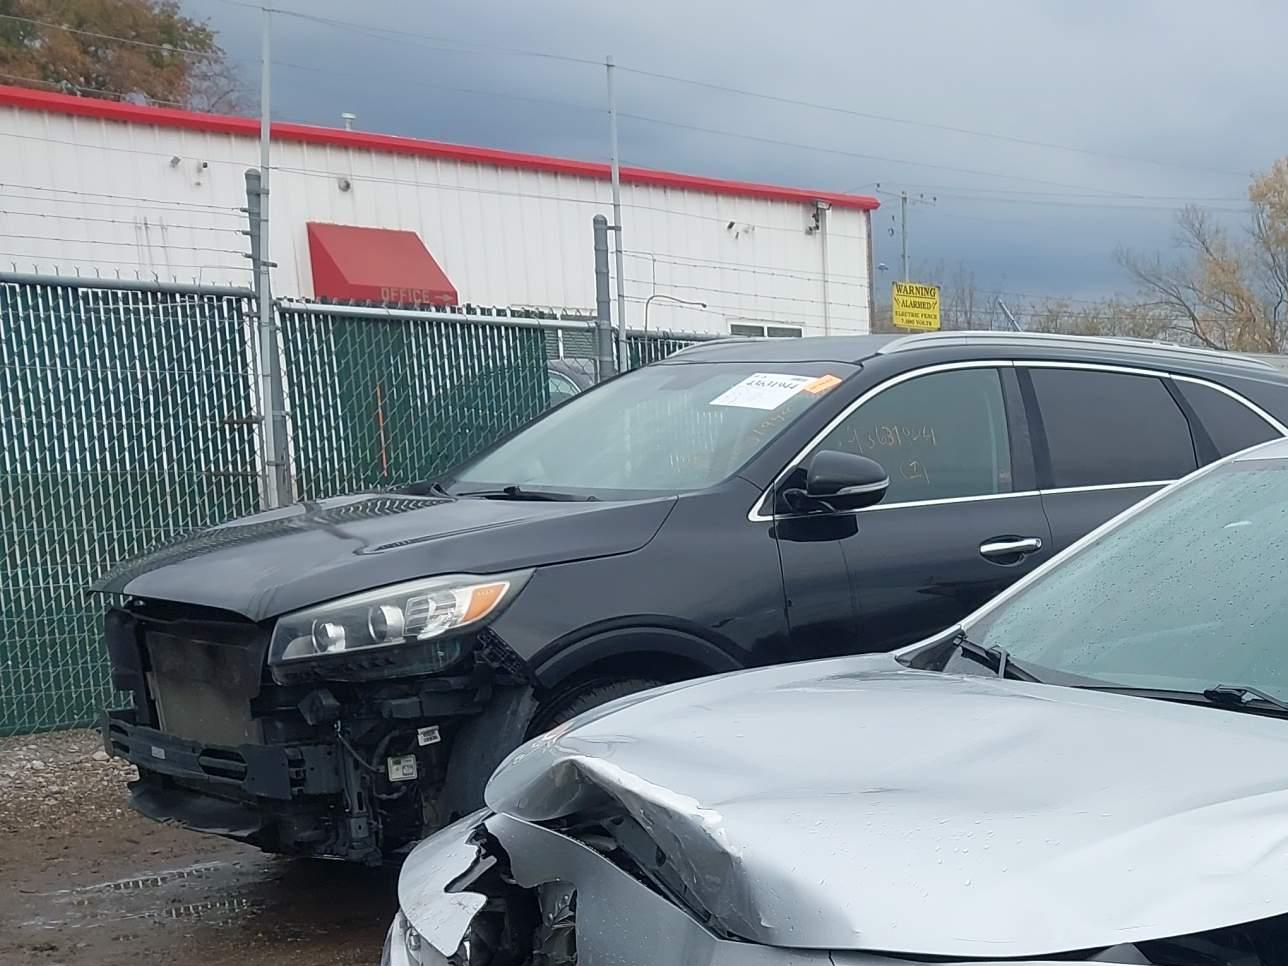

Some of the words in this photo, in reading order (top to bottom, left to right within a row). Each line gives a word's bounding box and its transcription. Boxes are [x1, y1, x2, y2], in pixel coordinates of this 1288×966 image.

[381, 287, 431, 304] OFFICE
[895, 282, 937, 297] WARNING
[901, 299, 932, 310] ALARMED
